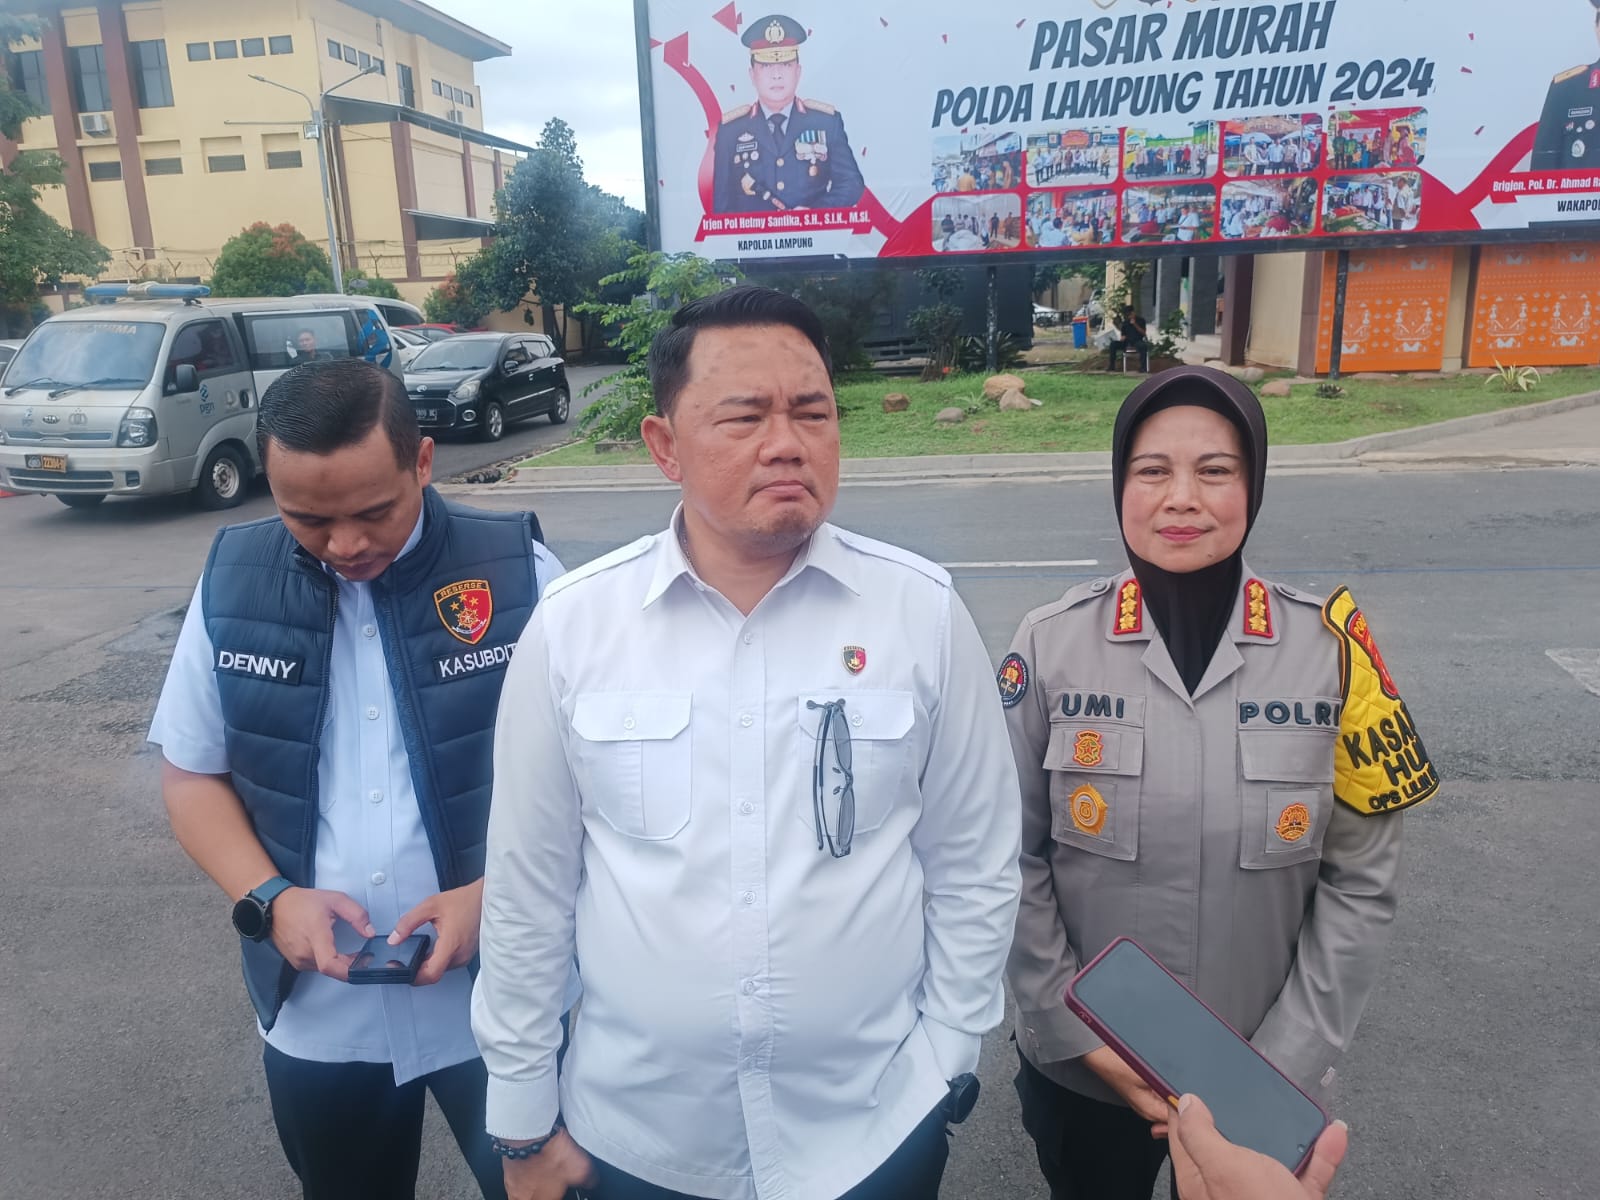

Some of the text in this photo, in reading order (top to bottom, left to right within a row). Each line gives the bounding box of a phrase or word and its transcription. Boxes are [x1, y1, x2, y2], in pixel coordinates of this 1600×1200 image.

[1029, 0, 1336, 71] PASAR MURAH
[932, 57, 1435, 128] POLDA LAMPUNG TAHUN 2024
[1528, 179, 1544, 190] Pol.
[1546, 178, 1558, 189] Dr.
[1560, 177, 1591, 189] Ahmad
[724, 217, 737, 229] Pol
[739, 215, 766, 229] Helmy
[738, 237, 813, 251] KAPOLDA LAMPUNG
[439, 582, 483, 598] RESERSE
[218, 650, 297, 680] DENNY
[1061, 693, 1125, 719] UMI
[1239, 700, 1340, 727] POLRI
[1368, 789, 1402, 810] OPS
